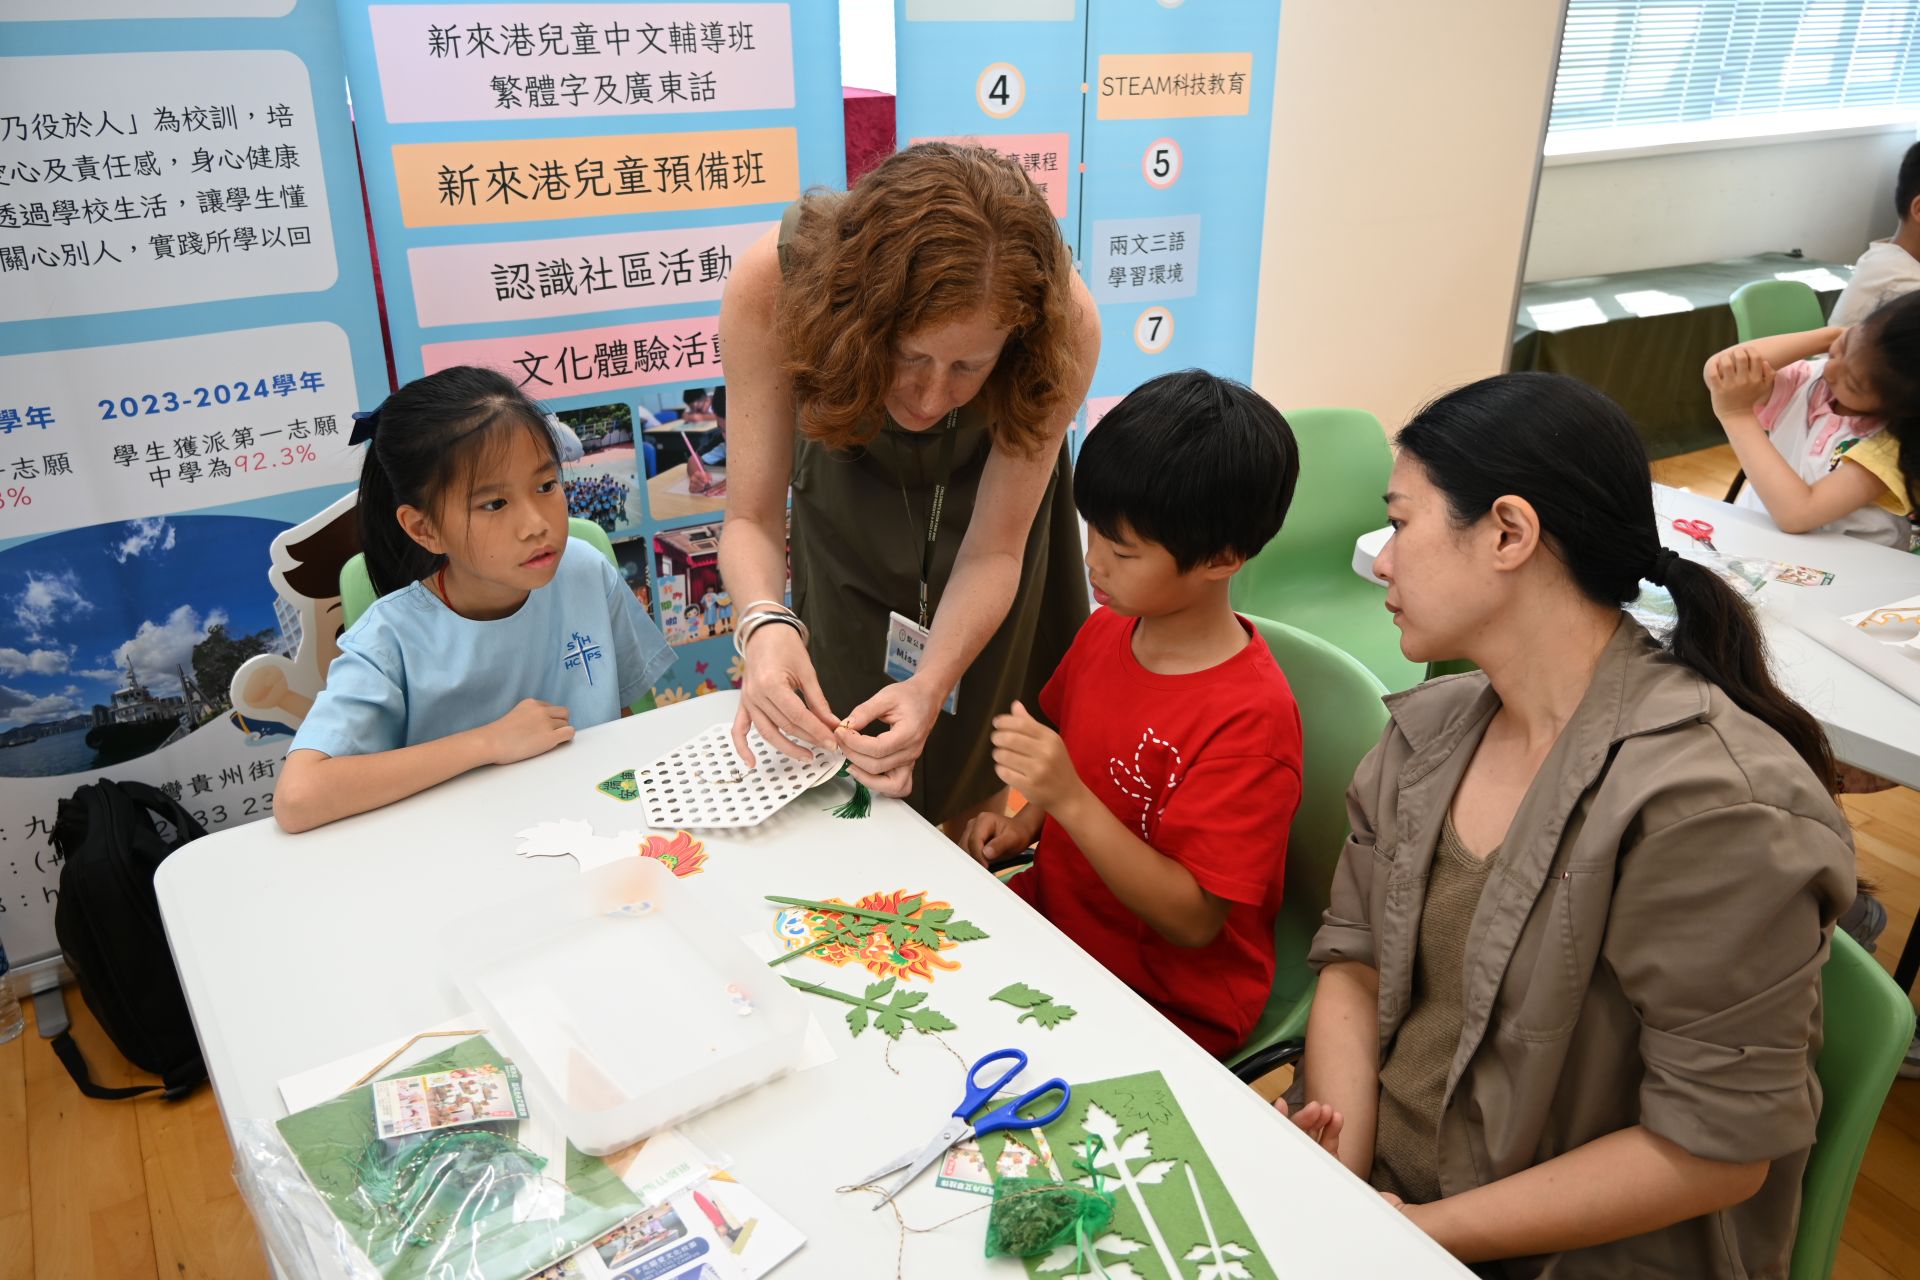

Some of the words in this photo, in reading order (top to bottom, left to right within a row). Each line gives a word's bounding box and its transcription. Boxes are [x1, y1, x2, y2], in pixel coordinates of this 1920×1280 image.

[427, 21, 756, 59] 新來港兒童中文輔導班
[489, 71, 717, 110] 繁體字及廣東話
[988, 74, 1010, 106] 4
[1102, 72, 1247, 97] STEAM科技教育
[437, 148, 767, 207] 新來港兒童預備班
[1153, 149, 1170, 178] 5
[1109, 231, 1186, 257] 兩文三語
[490, 244, 732, 302] 認識社區活動
[1108, 262, 1185, 289] 學習環境
[1148, 315, 1164, 342] 7
[98, 371, 326, 421] 2023-2024學年
[0, 406, 55, 434] 學年
[113, 414, 339, 468] 學生獲派第一志願
[0, 452, 73, 480] 志願
